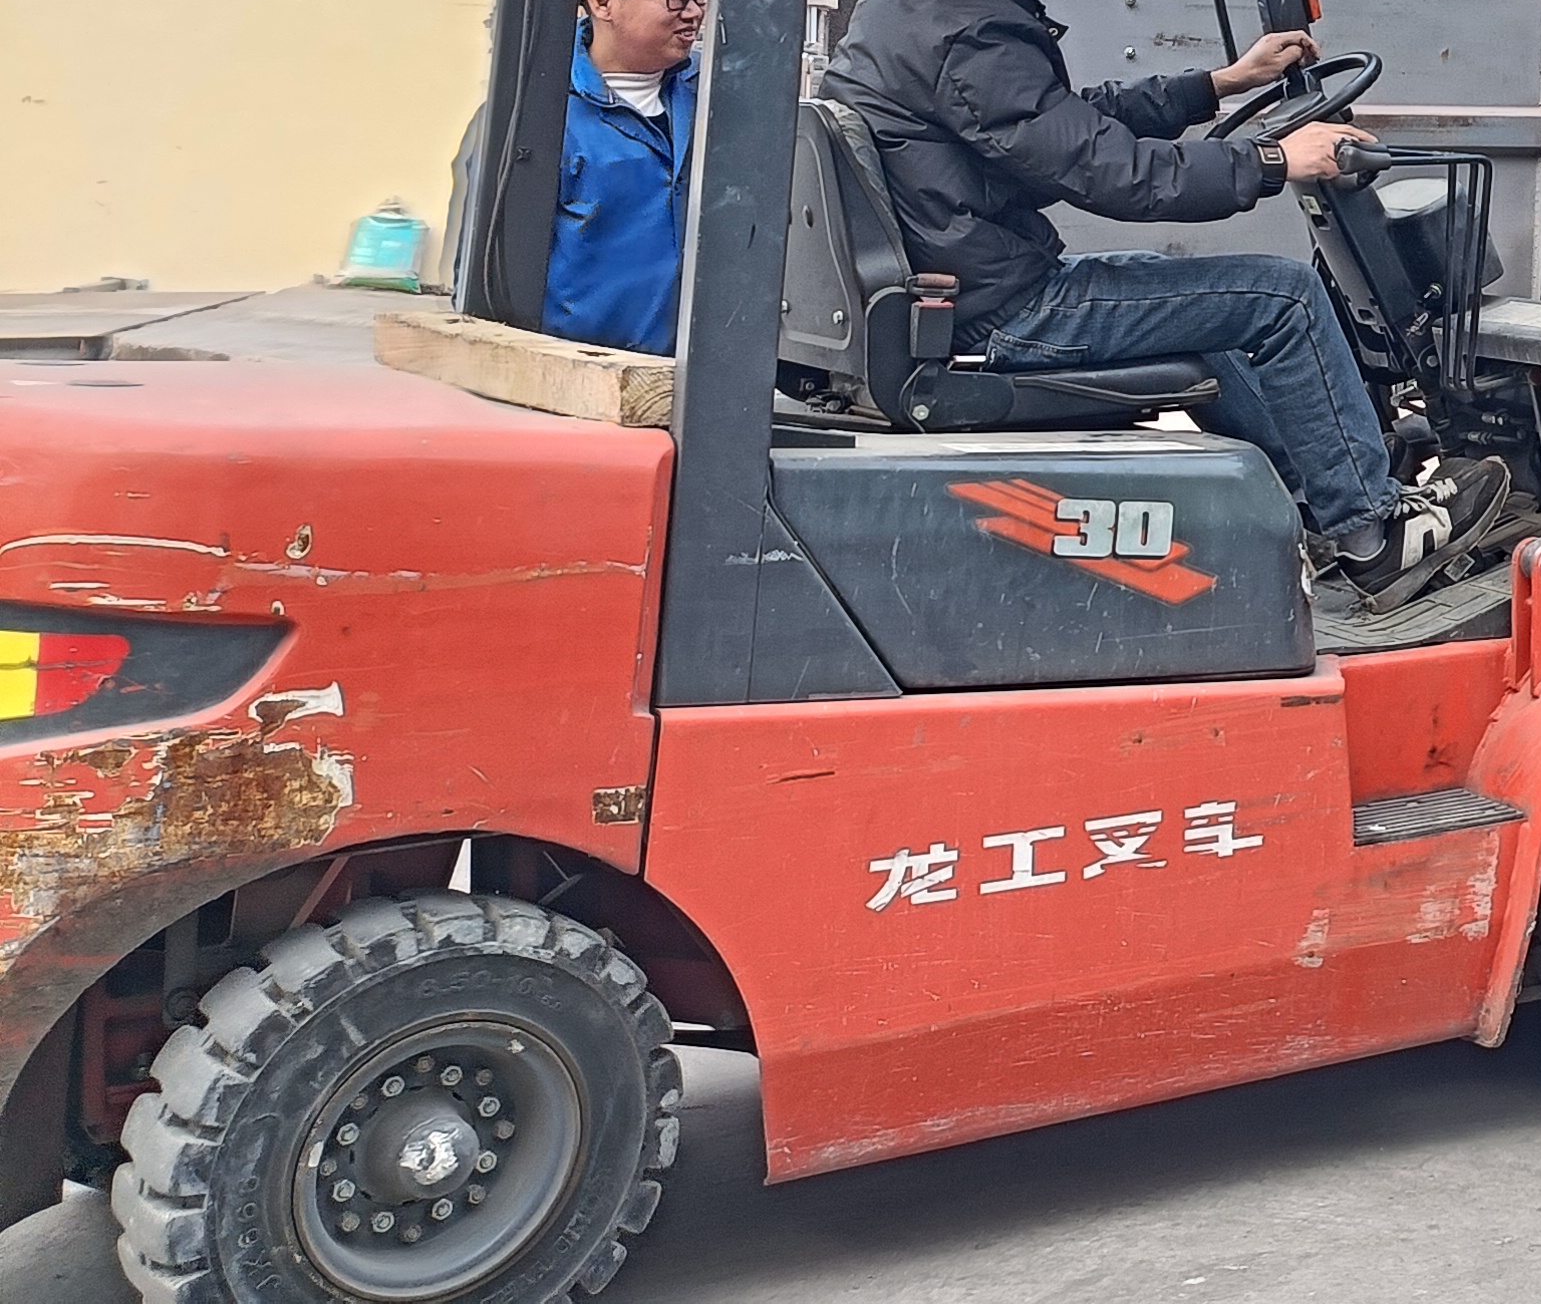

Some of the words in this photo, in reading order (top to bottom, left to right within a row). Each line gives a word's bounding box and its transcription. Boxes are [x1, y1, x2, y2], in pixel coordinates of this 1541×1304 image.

[1053, 498, 1175, 558] 30
[865, 800, 1265, 913] 龙工叉车
